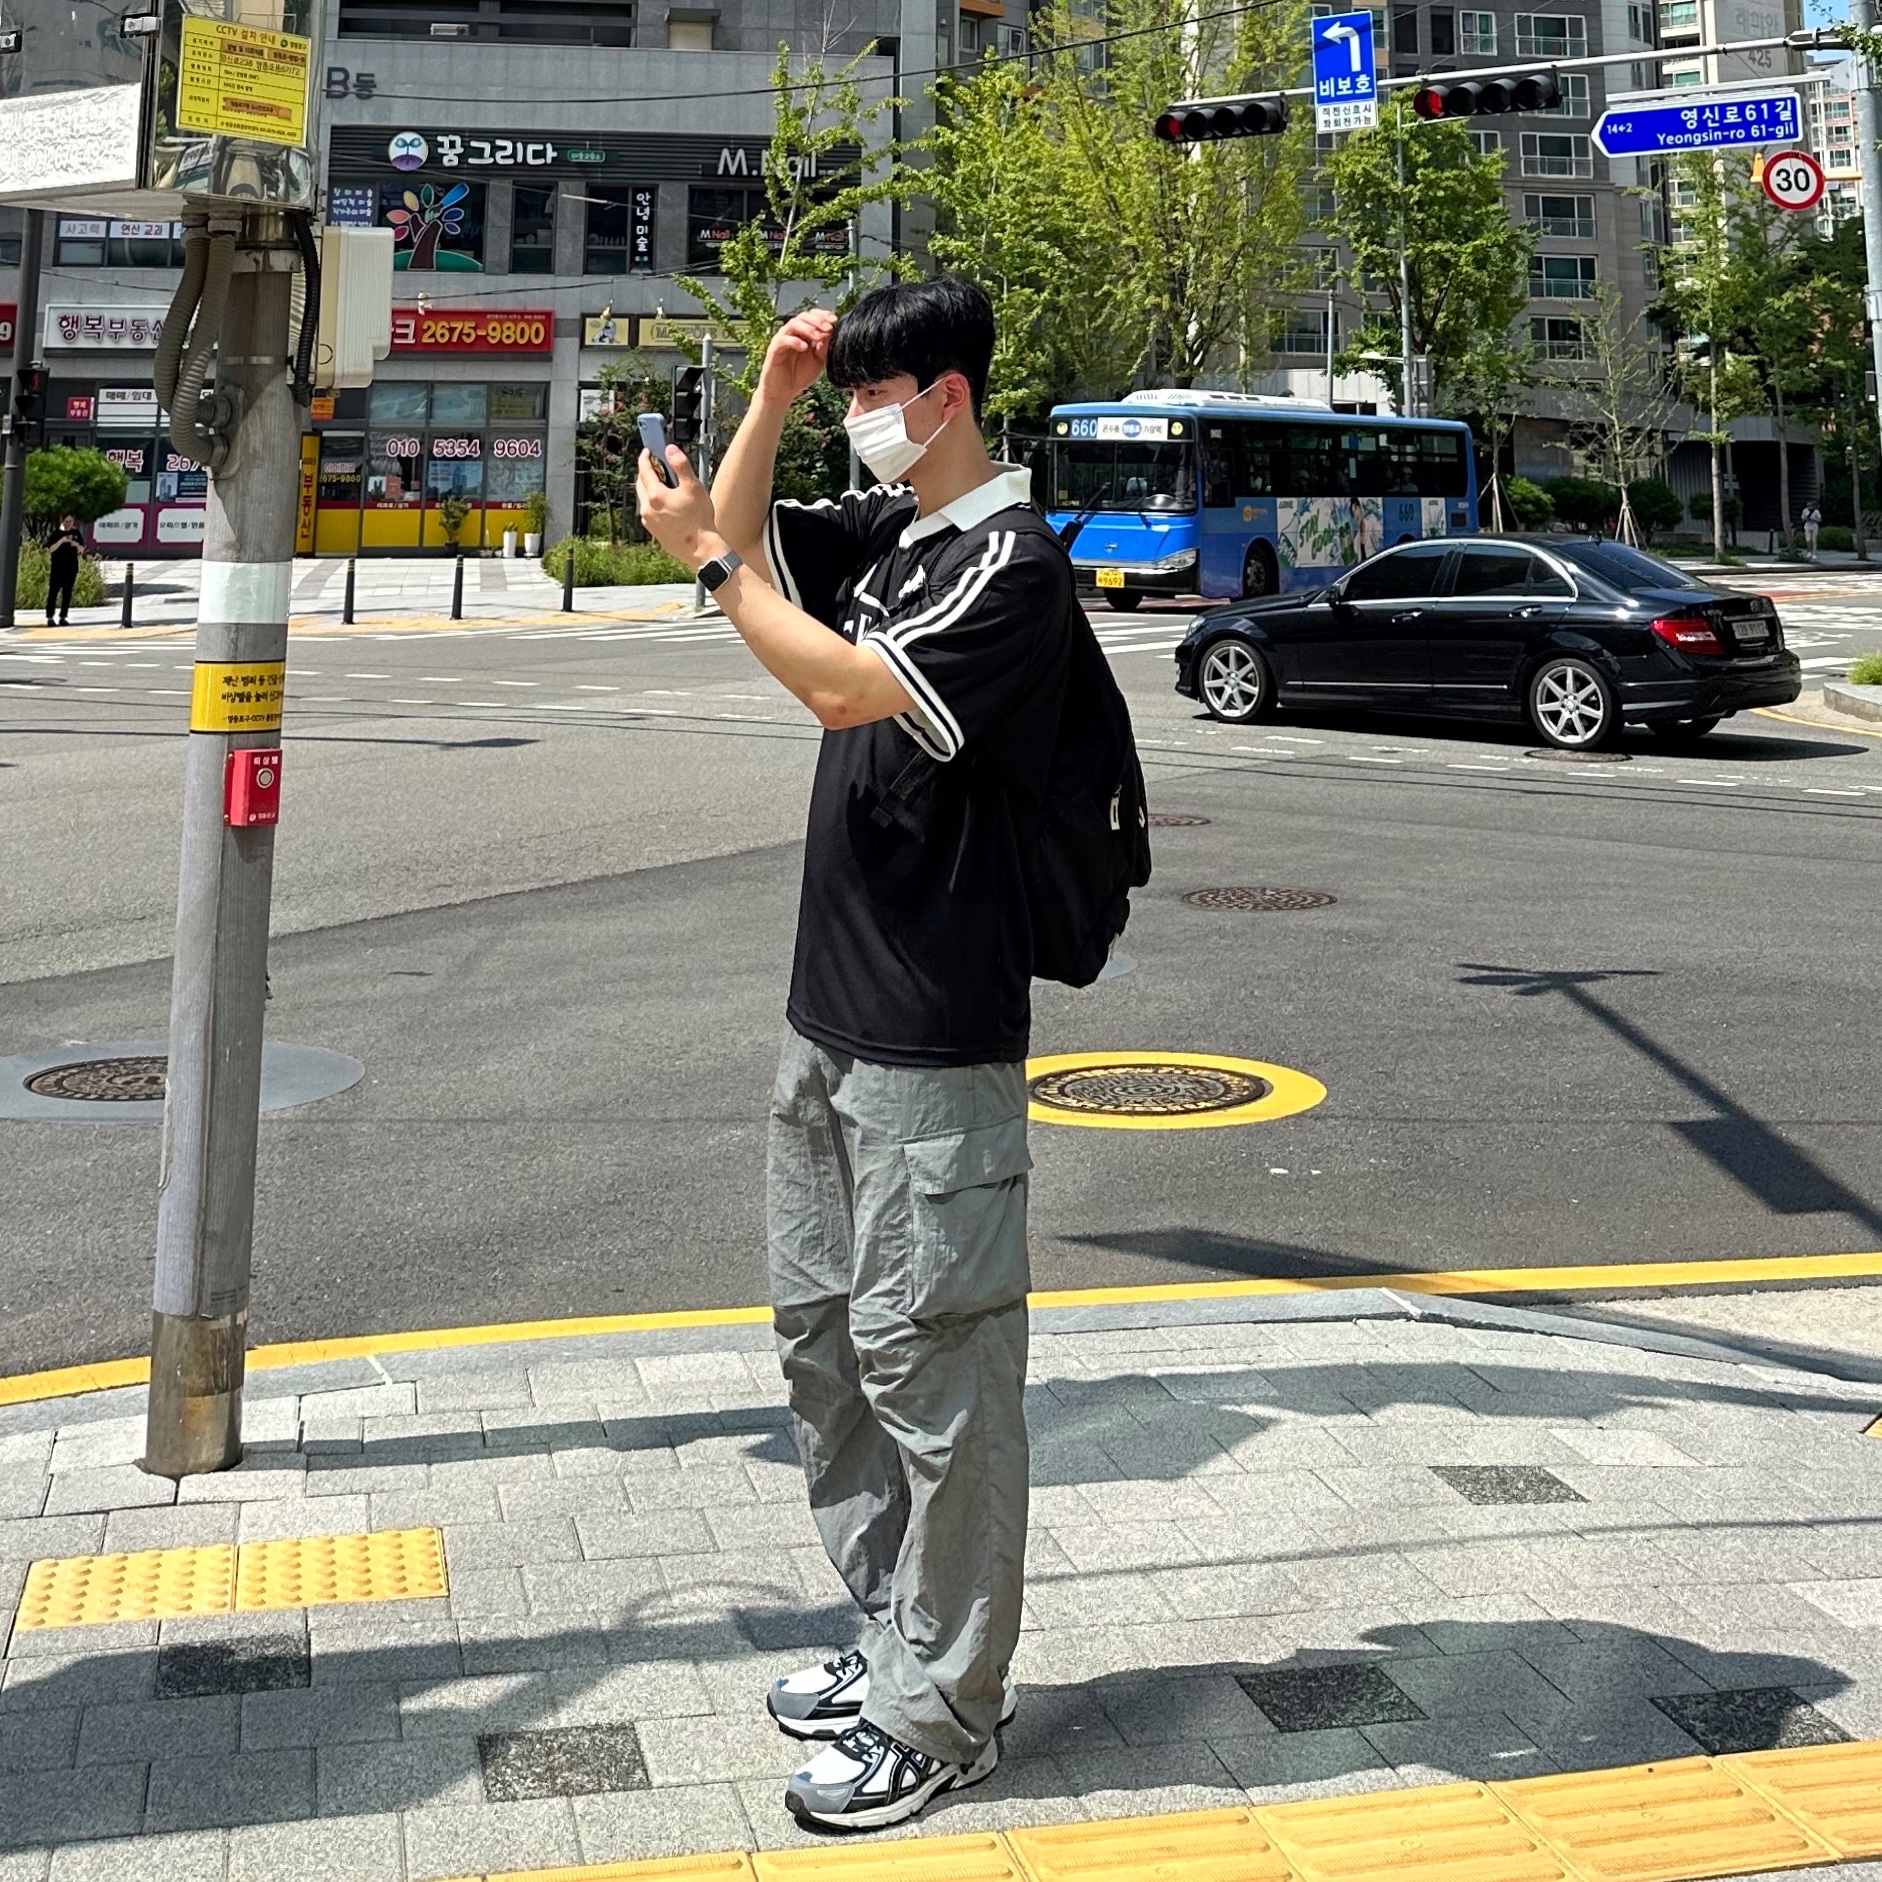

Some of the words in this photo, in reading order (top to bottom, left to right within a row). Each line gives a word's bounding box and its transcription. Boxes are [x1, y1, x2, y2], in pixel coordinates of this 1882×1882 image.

[216, 24, 238, 37] CCTV
[241, 28, 256, 41] 설치
[259, 31, 276, 46] 안내
[1747, 49, 1773, 69] 425
[325, 66, 377, 100] B동
[1319, 73, 1373, 98] 비보호
[1321, 103, 1372, 117] 직진신호시
[1680, 99, 1793, 130] 영신로61길
[1322, 115, 1373, 129] 좌회전가능
[1656, 127, 1746, 147] Yeongsin-ro
[1751, 121, 1795, 141] 61-gil
[436, 134, 558, 167] 꿈그리다
[1775, 167, 1811, 193] 30
[635, 192, 652, 221] 안녕
[121, 223, 141, 236] 연산
[635, 224, 650, 252] 미술
[701, 229, 711, 240] M
[711, 229, 731, 240] Nail
[769, 230, 787, 241] Nai
[815, 231, 826, 242] M
[0, 321, 13, 342] 9
[391, 318, 416, 344] 크
[421, 319, 546, 346] 2675-9800
[1071, 418, 1098, 437] 660
[386, 438, 421, 458] 010
[432, 438, 481, 458] 5354
[493, 438, 542, 458] 9604
[166, 453, 208, 472] 26
[301, 473, 313, 540] 부동산
